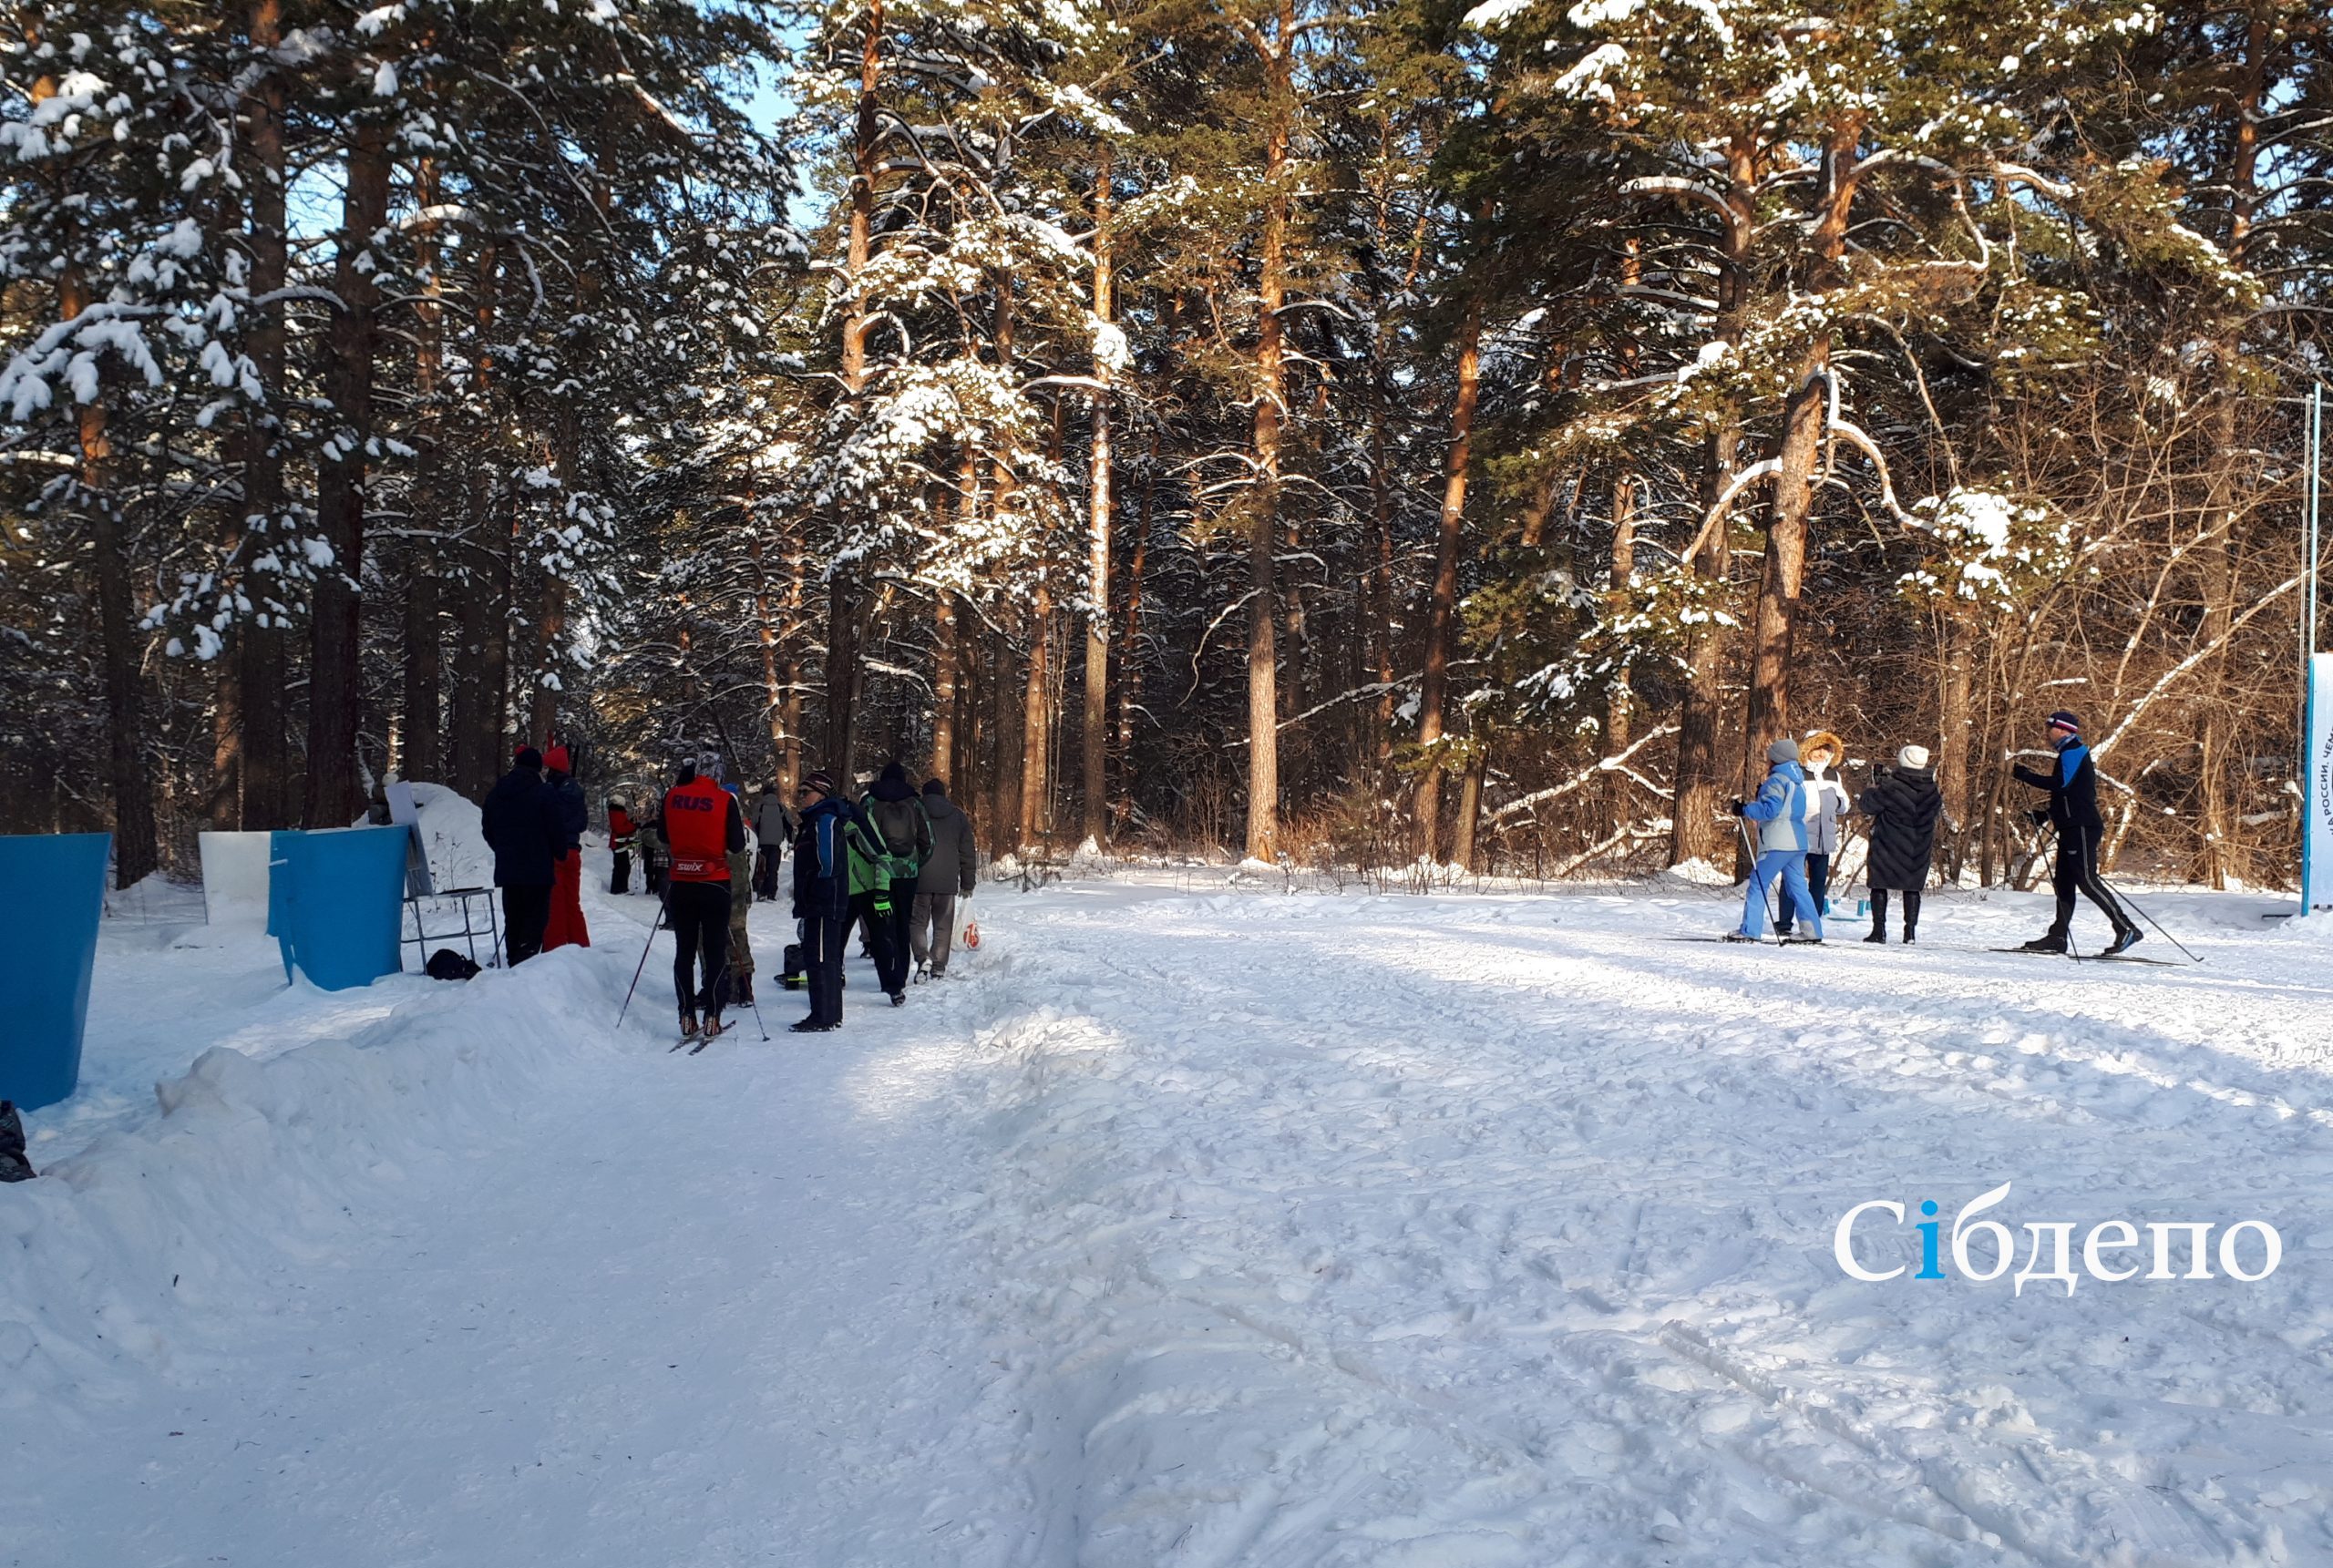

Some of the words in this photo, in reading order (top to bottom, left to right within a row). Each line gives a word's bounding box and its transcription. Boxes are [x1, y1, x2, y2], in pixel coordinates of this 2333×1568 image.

[2323, 726, 2333, 758] ЧЕМ
[672, 794, 714, 812] RUS
[2320, 762, 2331, 816] РОССИИ.
